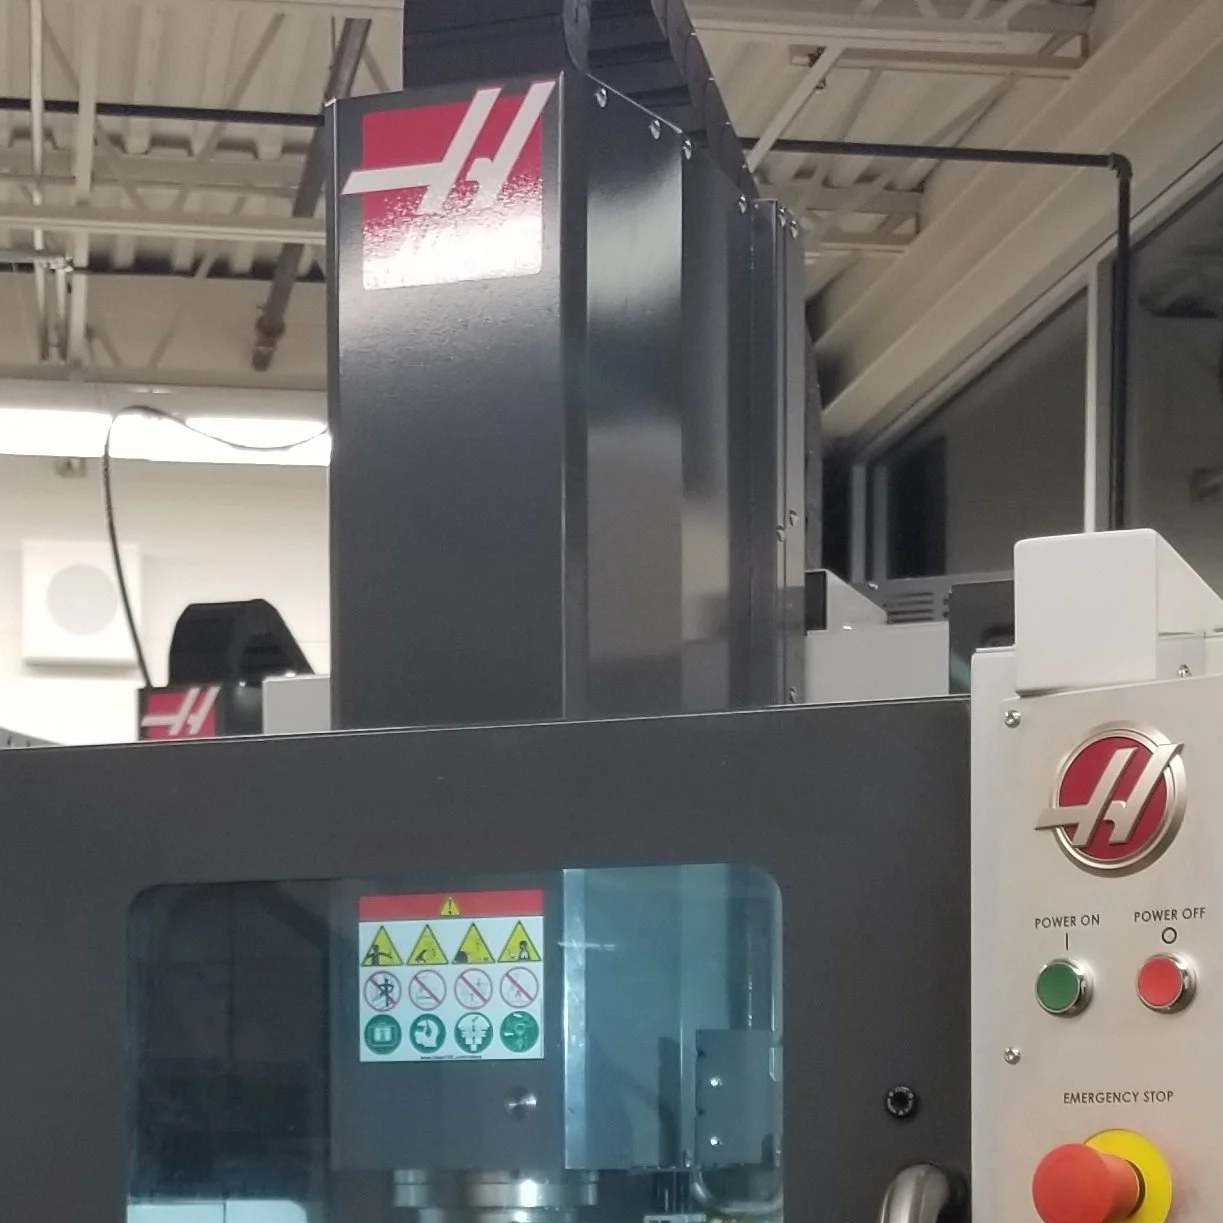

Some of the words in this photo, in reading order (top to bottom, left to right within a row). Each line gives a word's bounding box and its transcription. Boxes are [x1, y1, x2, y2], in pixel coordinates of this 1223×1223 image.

[1034, 915, 1076, 930] POWER
[1080, 914, 1101, 927] ON
[1133, 908, 1178, 923] POWER
[1181, 906, 1206, 920] OFF
[1063, 1091, 1139, 1104] EMERGENCY
[1143, 1090, 1174, 1103] STOP
